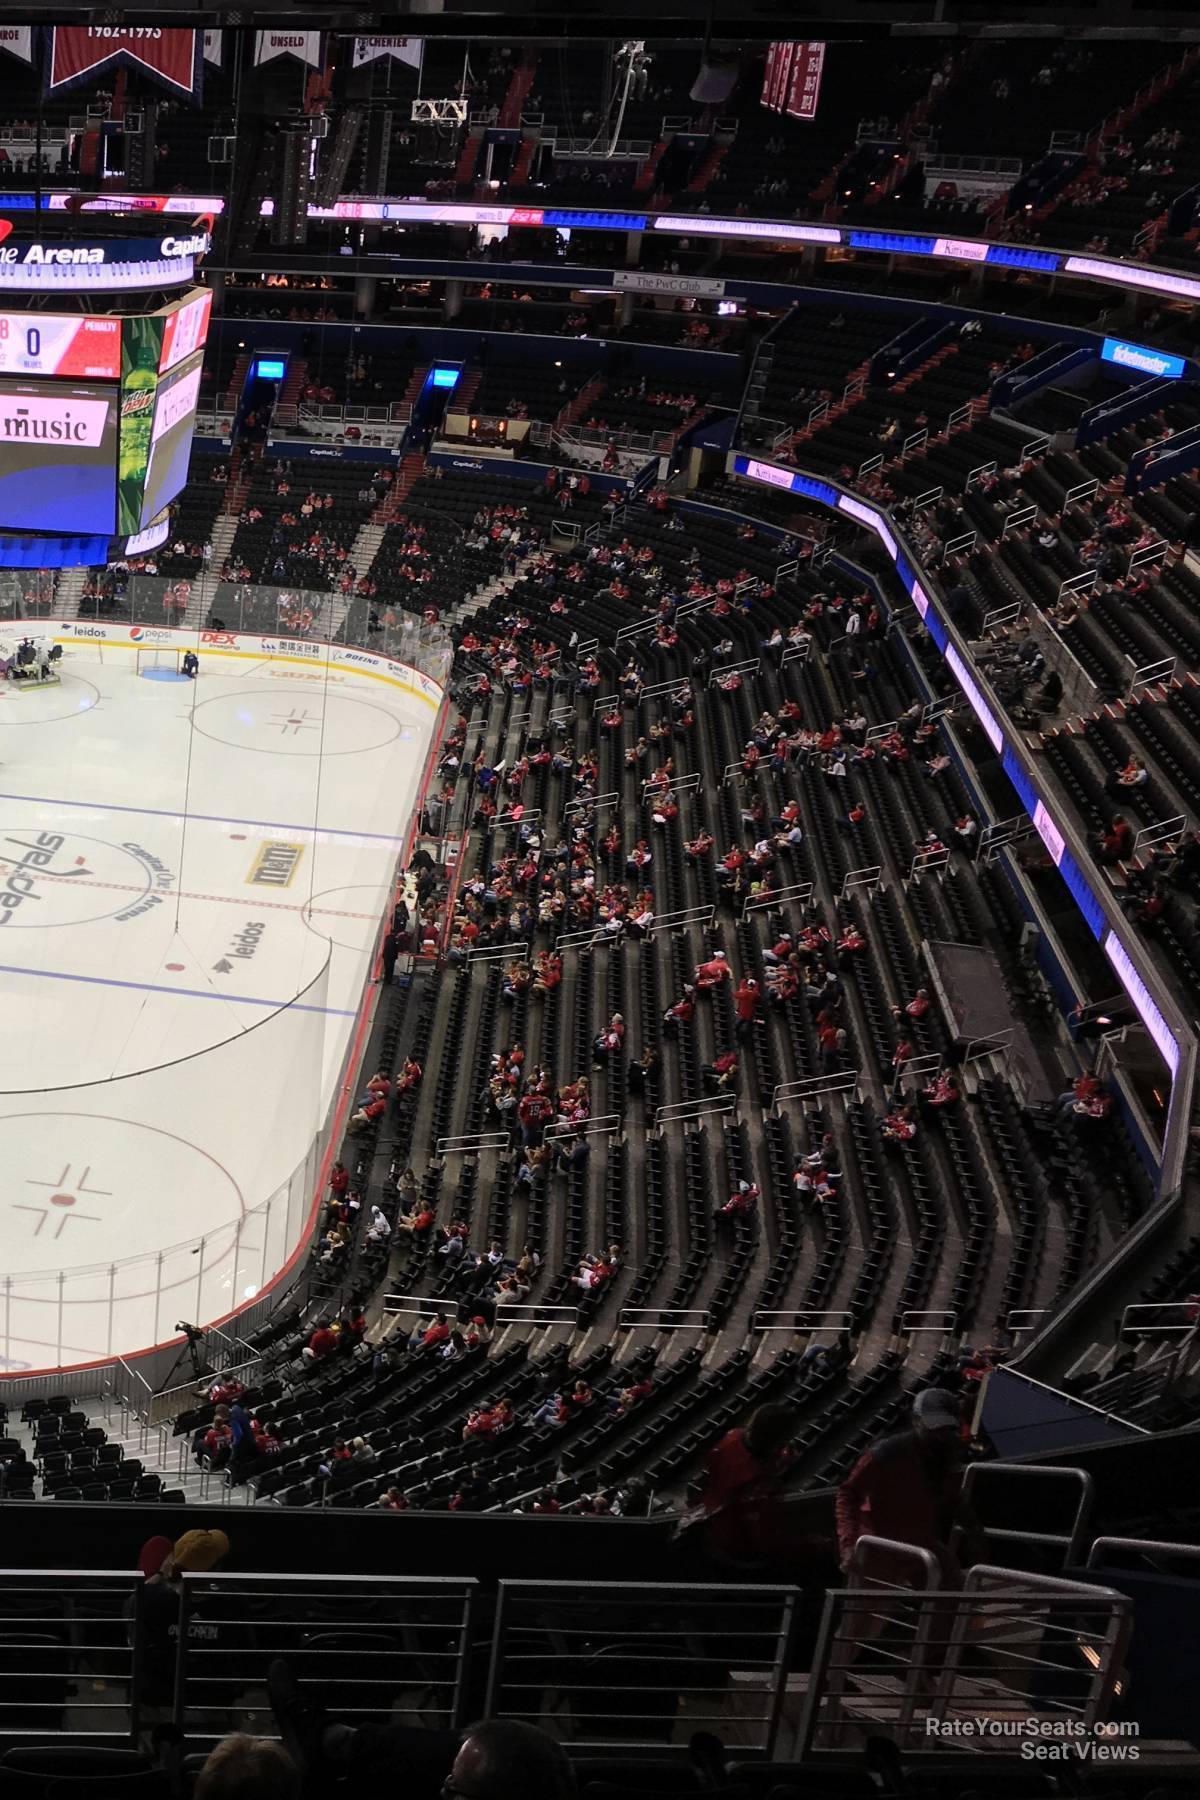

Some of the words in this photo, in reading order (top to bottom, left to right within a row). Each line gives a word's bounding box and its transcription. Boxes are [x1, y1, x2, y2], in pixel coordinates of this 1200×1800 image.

[270, 36, 304, 48] UNSELD
[382, 203, 389, 218] 0
[160, 232, 208, 258] Capital
[24, 244, 104, 264] Arena
[637, 277, 654, 288] The
[656, 279, 678, 290] PwC
[680, 280, 701, 291] Club
[84, 321, 117, 333] PENALTY
[27, 327, 41, 357] 0
[5, 414, 88, 441] music
[74, 626, 106, 638] leidos
[145, 629, 173, 642] pepsi
[202, 633, 237, 645] DEX
[344, 652, 380, 666] BOEING
[114, 895, 164, 923] Arena
[224, 921, 267, 960] leidos
[167, 1623, 220, 1641] OVCHKIN
